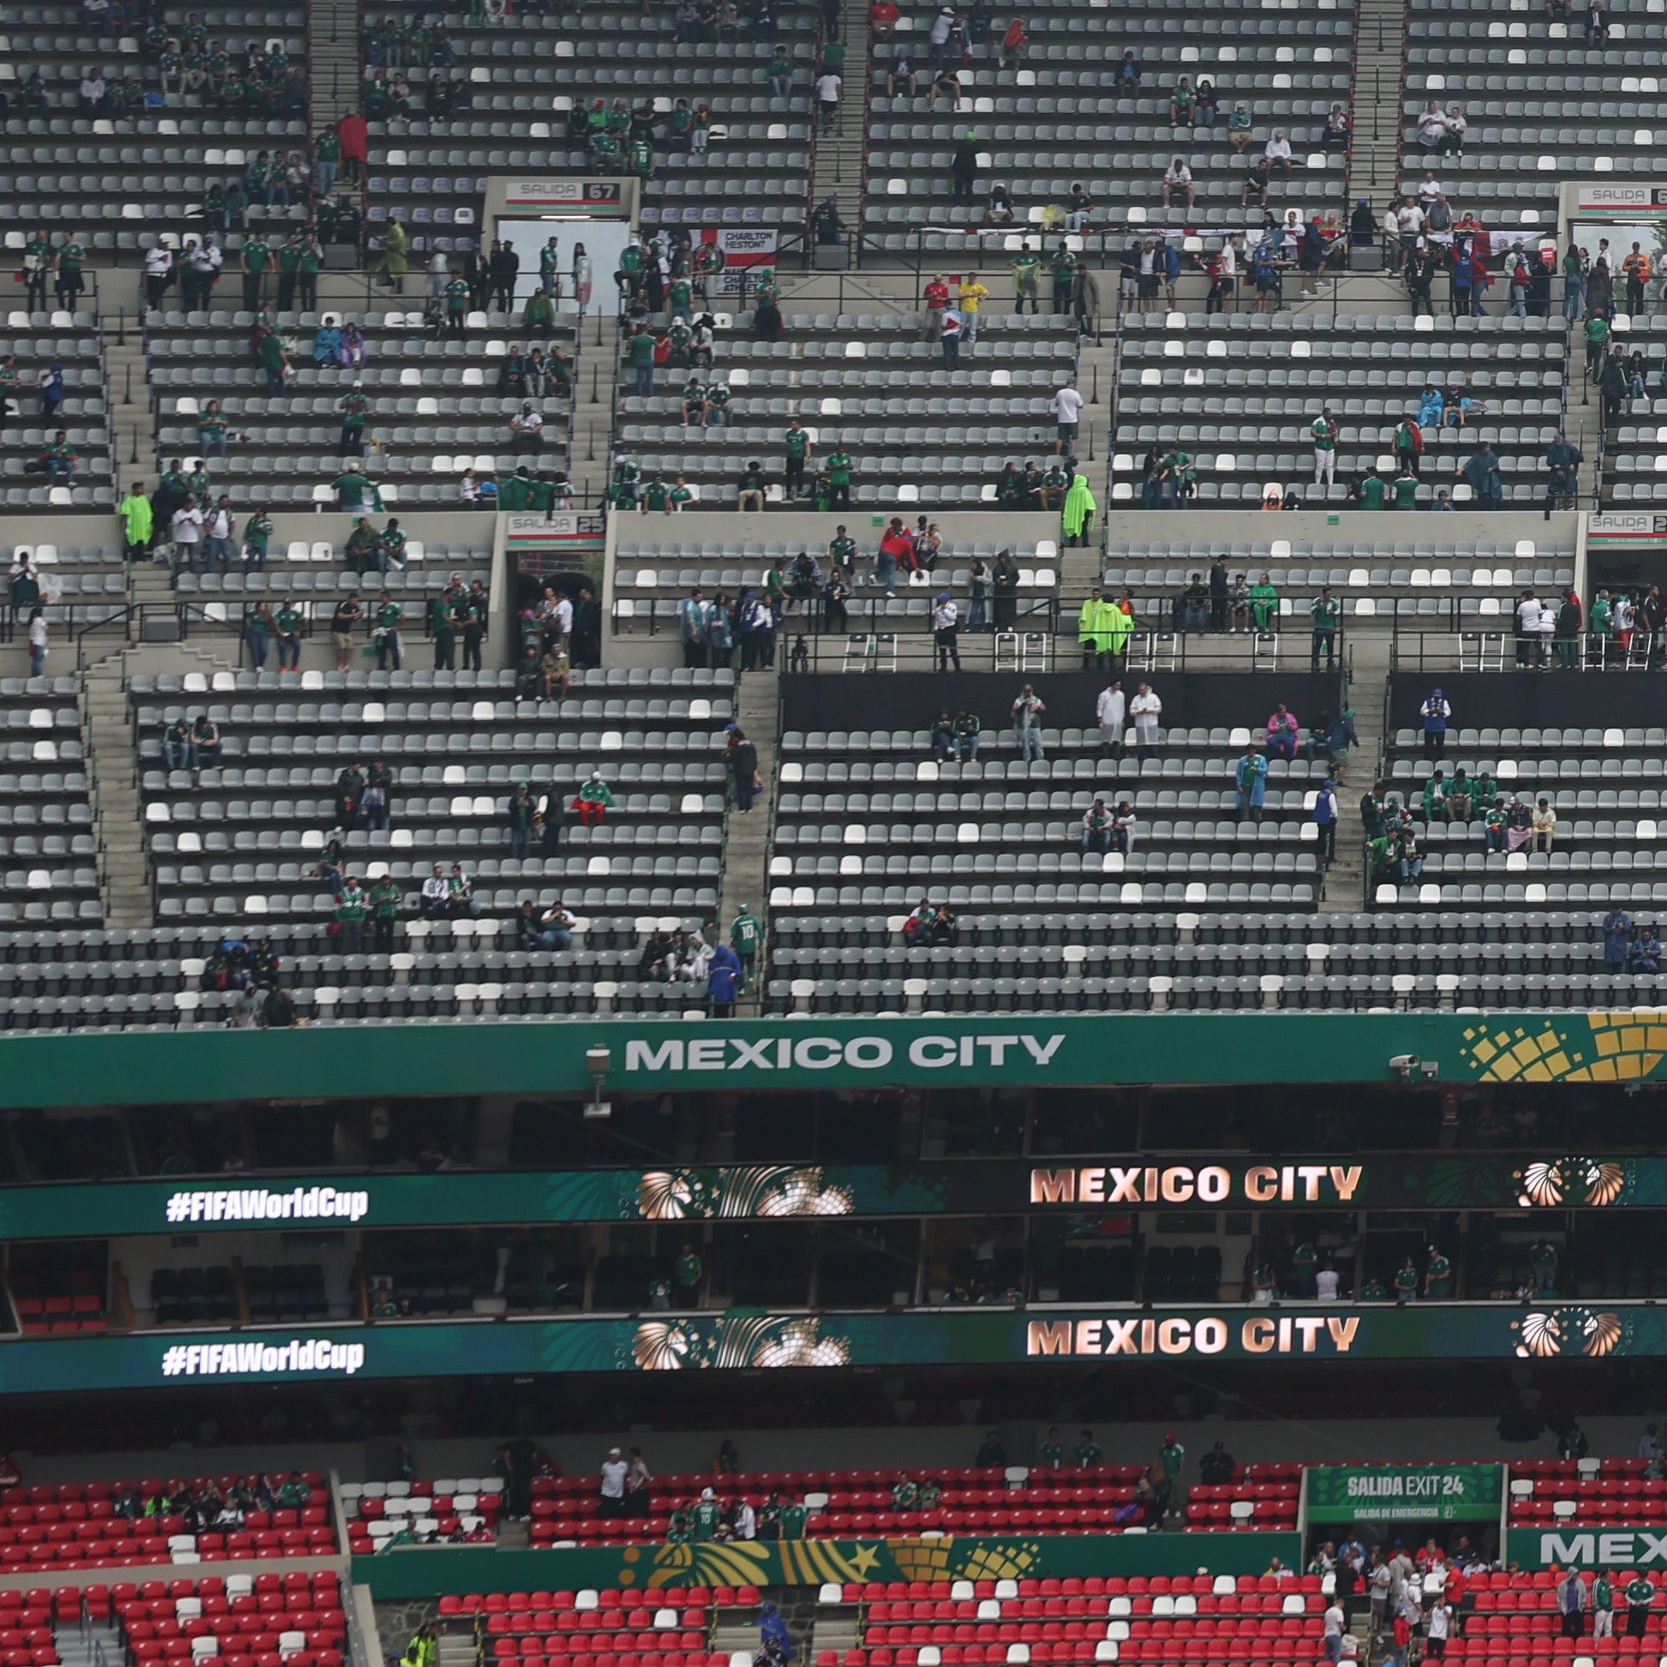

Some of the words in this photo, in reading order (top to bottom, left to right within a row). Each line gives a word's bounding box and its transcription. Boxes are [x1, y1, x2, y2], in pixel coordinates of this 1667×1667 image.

[521, 185, 576, 196] SALIDA
[589, 185, 615, 199] 67
[1592, 190, 1645, 200] SALIDA
[725, 232, 772, 240] CHARLTON
[725, 240, 765, 249] HESTON?
[512, 519, 570, 529] SALIDA
[578, 518, 604, 533] 25
[1593, 517, 1647, 527] SALIDA
[741, 925, 755, 940] 10
[626, 1037, 892, 1070] MEXICO
[909, 1035, 1065, 1067] CITY
[1031, 1167, 1229, 1202] MEXICO
[1245, 1167, 1362, 1200] CITY
[167, 1187, 367, 1221] #FIFAWorldCup
[1028, 1318, 1226, 1355] MEXICO
[1242, 1318, 1359, 1352] CITY
[162, 1340, 363, 1375] #FIFAWorldCup
[1348, 1476, 1402, 1496] SALIDA
[1405, 1475, 1440, 1496] EXIT
[1442, 1476, 1463, 1495] 24
[1354, 1508, 1380, 1518] SALIDA
[1381, 1508, 1390, 1518] DE
[1392, 1508, 1439, 1518] EMERGENCIA
